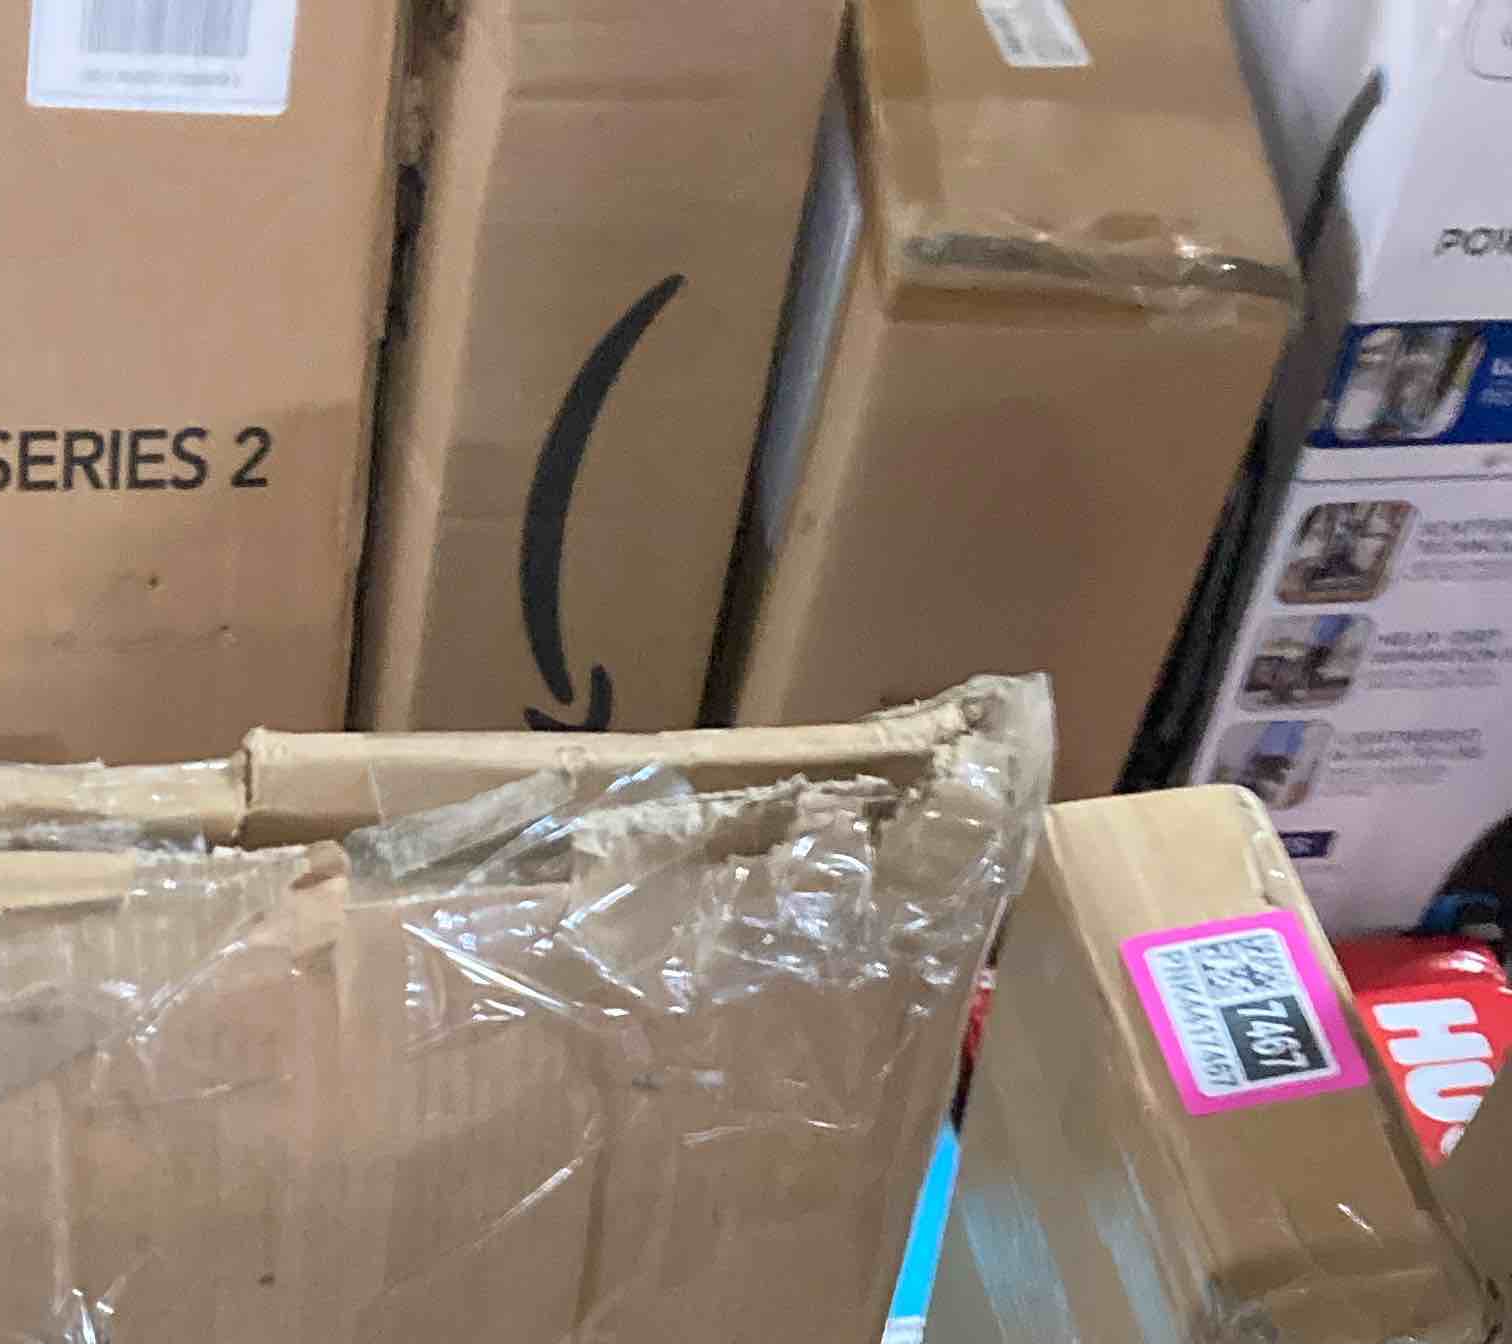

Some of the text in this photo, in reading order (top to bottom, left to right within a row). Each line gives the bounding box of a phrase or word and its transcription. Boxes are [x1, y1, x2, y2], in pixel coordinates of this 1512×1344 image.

[231, 427, 272, 489] 2
[1236, 999, 1310, 1069] 7467
[1372, 997, 1495, 1156] HU
